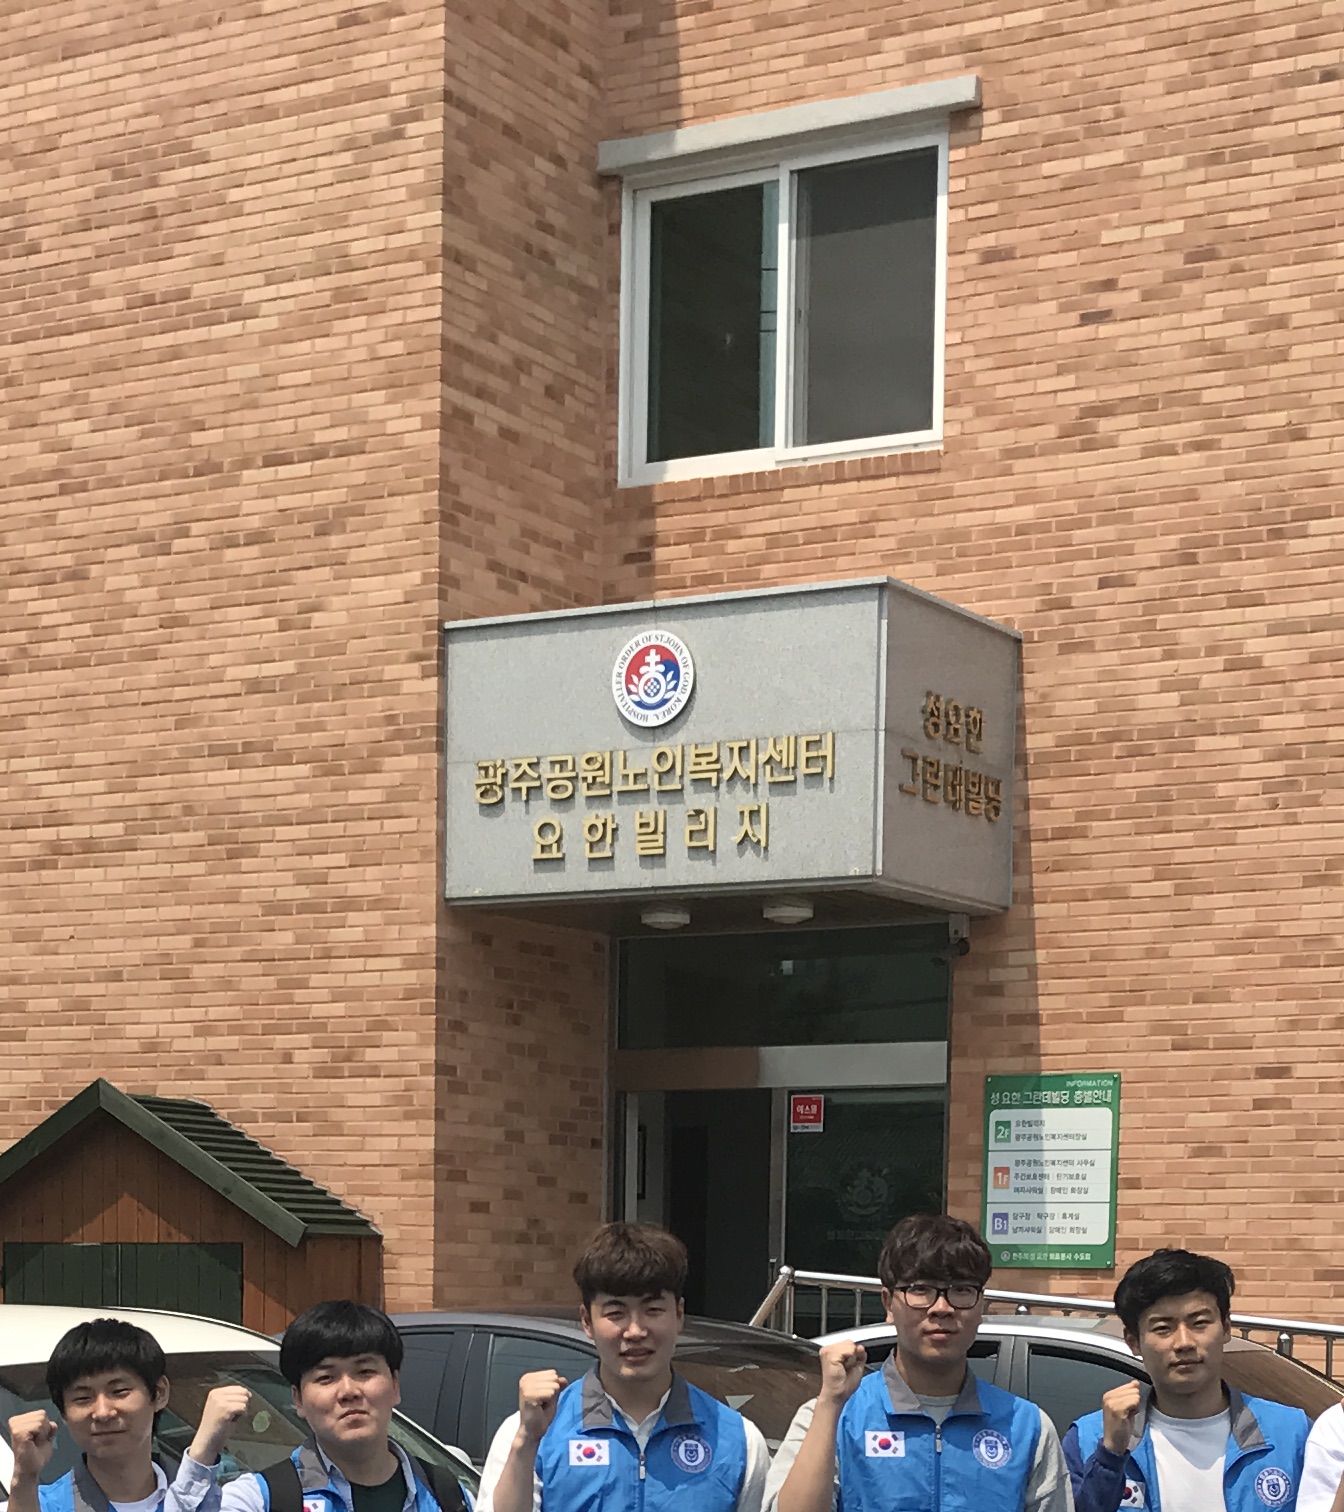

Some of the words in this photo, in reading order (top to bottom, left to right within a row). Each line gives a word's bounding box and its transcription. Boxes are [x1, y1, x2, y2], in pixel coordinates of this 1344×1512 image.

[619, 640, 641, 669] ORDER
[641, 634, 653, 644] OF
[680, 656, 690, 668] OF
[922, 690, 983, 754] 성요한
[474, 731, 834, 806] 광주공원노인복지센터
[1065, 1079, 1114, 1087] INFORMATION
[1073, 1089, 1113, 1104] 층별안내
[996, 1126, 1010, 1139] 2F
[997, 1172, 1009, 1185] 1F
[994, 1217, 1008, 1230] B1
